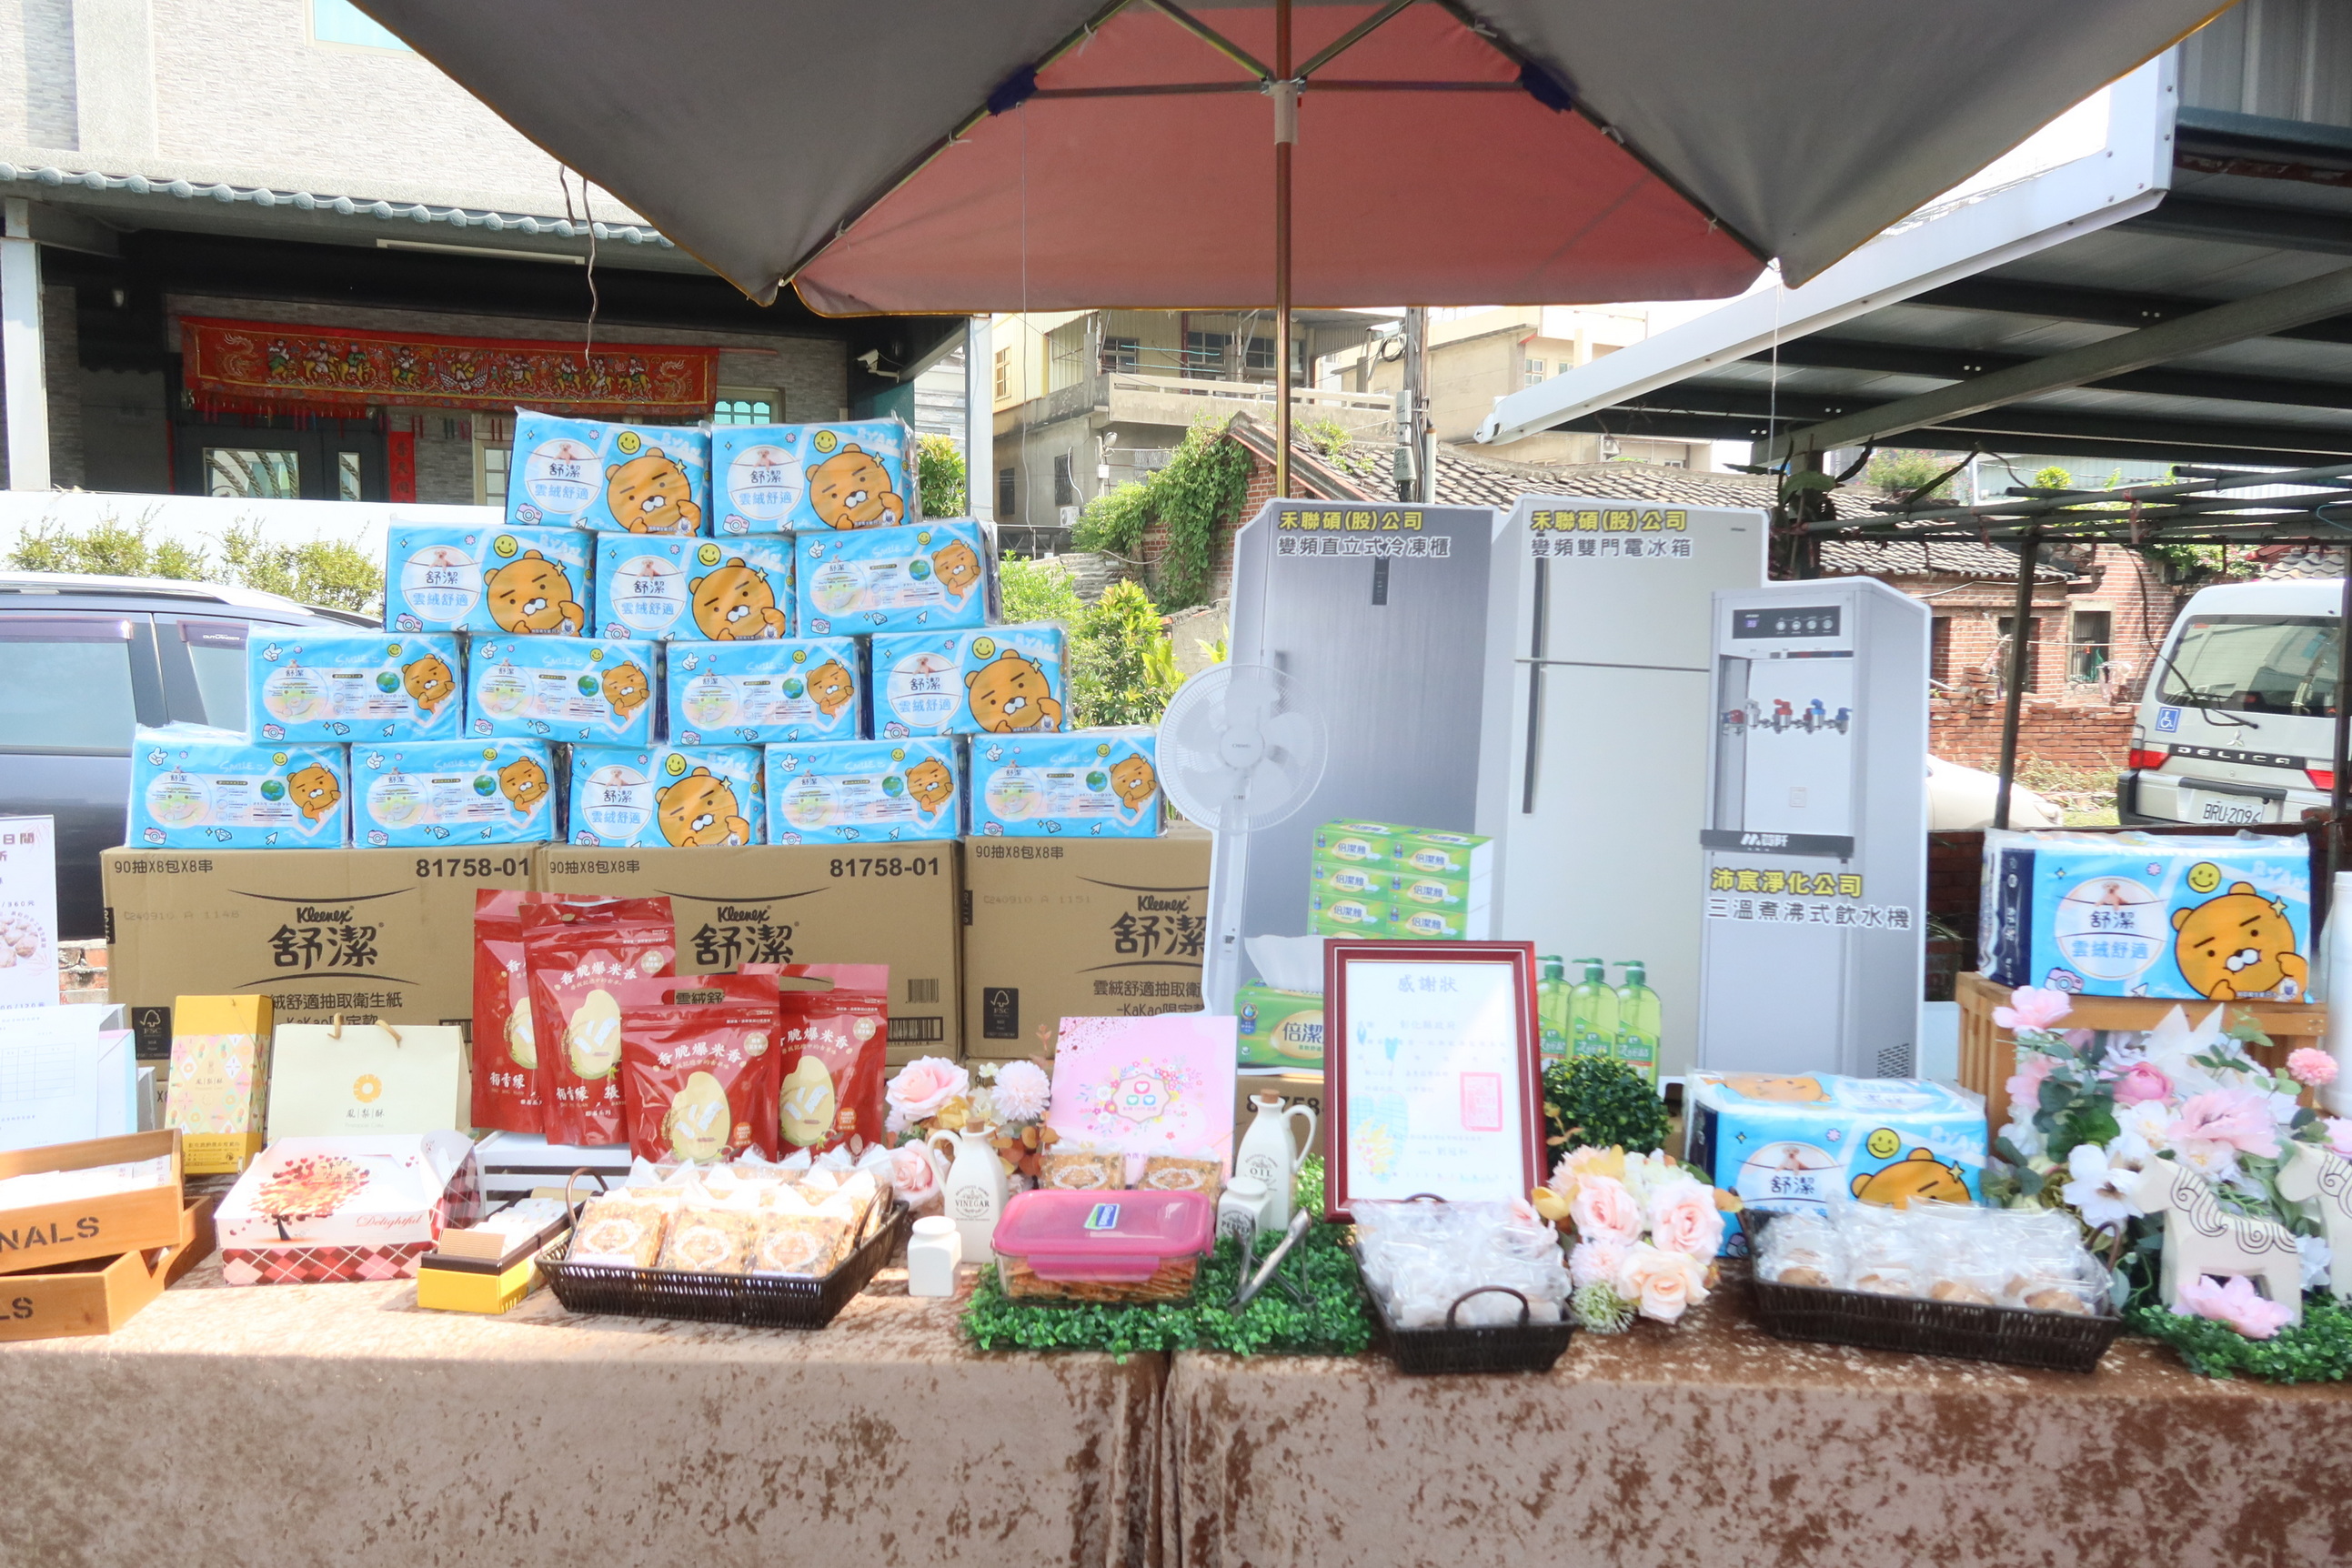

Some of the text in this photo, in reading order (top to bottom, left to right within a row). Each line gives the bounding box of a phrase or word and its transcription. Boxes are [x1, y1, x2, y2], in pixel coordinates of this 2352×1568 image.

[548, 463, 580, 477] 舒潔
[750, 470, 781, 483] 舒潔
[535, 485, 588, 500] 雲絨舒適
[739, 491, 792, 505] 雲絨舒適
[1279, 510, 1423, 531] 禾聯碩(股)公司
[1531, 509, 1687, 532] 禾聯碩(股)公司
[1277, 536, 1451, 557] 變頻直立式冷凍櫃
[1531, 538, 1693, 558] 變頻雙門電冰箱
[426, 571, 458, 585] 舒潔
[633, 581, 665, 594] 舒潔
[413, 593, 469, 607] 雲絨舒適
[622, 603, 675, 616] 雲絨舒適
[910, 677, 940, 690] 舒潔
[899, 699, 951, 712] 雲絨舒適
[2177, 746, 2290, 765] DELICA
[604, 790, 632, 803] 舒潔
[592, 810, 641, 824] 雲絨舒適
[2203, 803, 2261, 824] BRU-2096
[976, 845, 1064, 859] 90抽X8包X8串
[115, 859, 213, 874] 90抽X8包X8串
[416, 858, 529, 878] 81758-01
[549, 859, 640, 874] 90抽X8包X8串
[829, 858, 939, 878] 81758-01
[1711, 868, 1863, 898] 沛宸淨化公司
[1138, 896, 1189, 914] Kleenex
[1707, 897, 1911, 930] 三溫煮沸式飲水機
[297, 907, 353, 924] Kleenex
[717, 906, 769, 924] Kleenex
[2089, 912, 2136, 930] 舒潔
[1110, 912, 1207, 958] 舒潔
[267, 924, 378, 970] 舒潔
[689, 923, 794, 969] 舒潔
[2071, 940, 2149, 960] 雲絨舒適
[1398, 974, 1459, 992] 感謝狀
[270, 991, 403, 1010] 絨舒適抽取衛生紙
[1282, 1022, 1324, 1043] 倍潔
[658, 1041, 742, 1066] 香脆爆米香
[1250, 1167, 1272, 1177] OIL
[1771, 1175, 1815, 1195] 舒潔
[356, 1214, 424, 1230] Delightful
